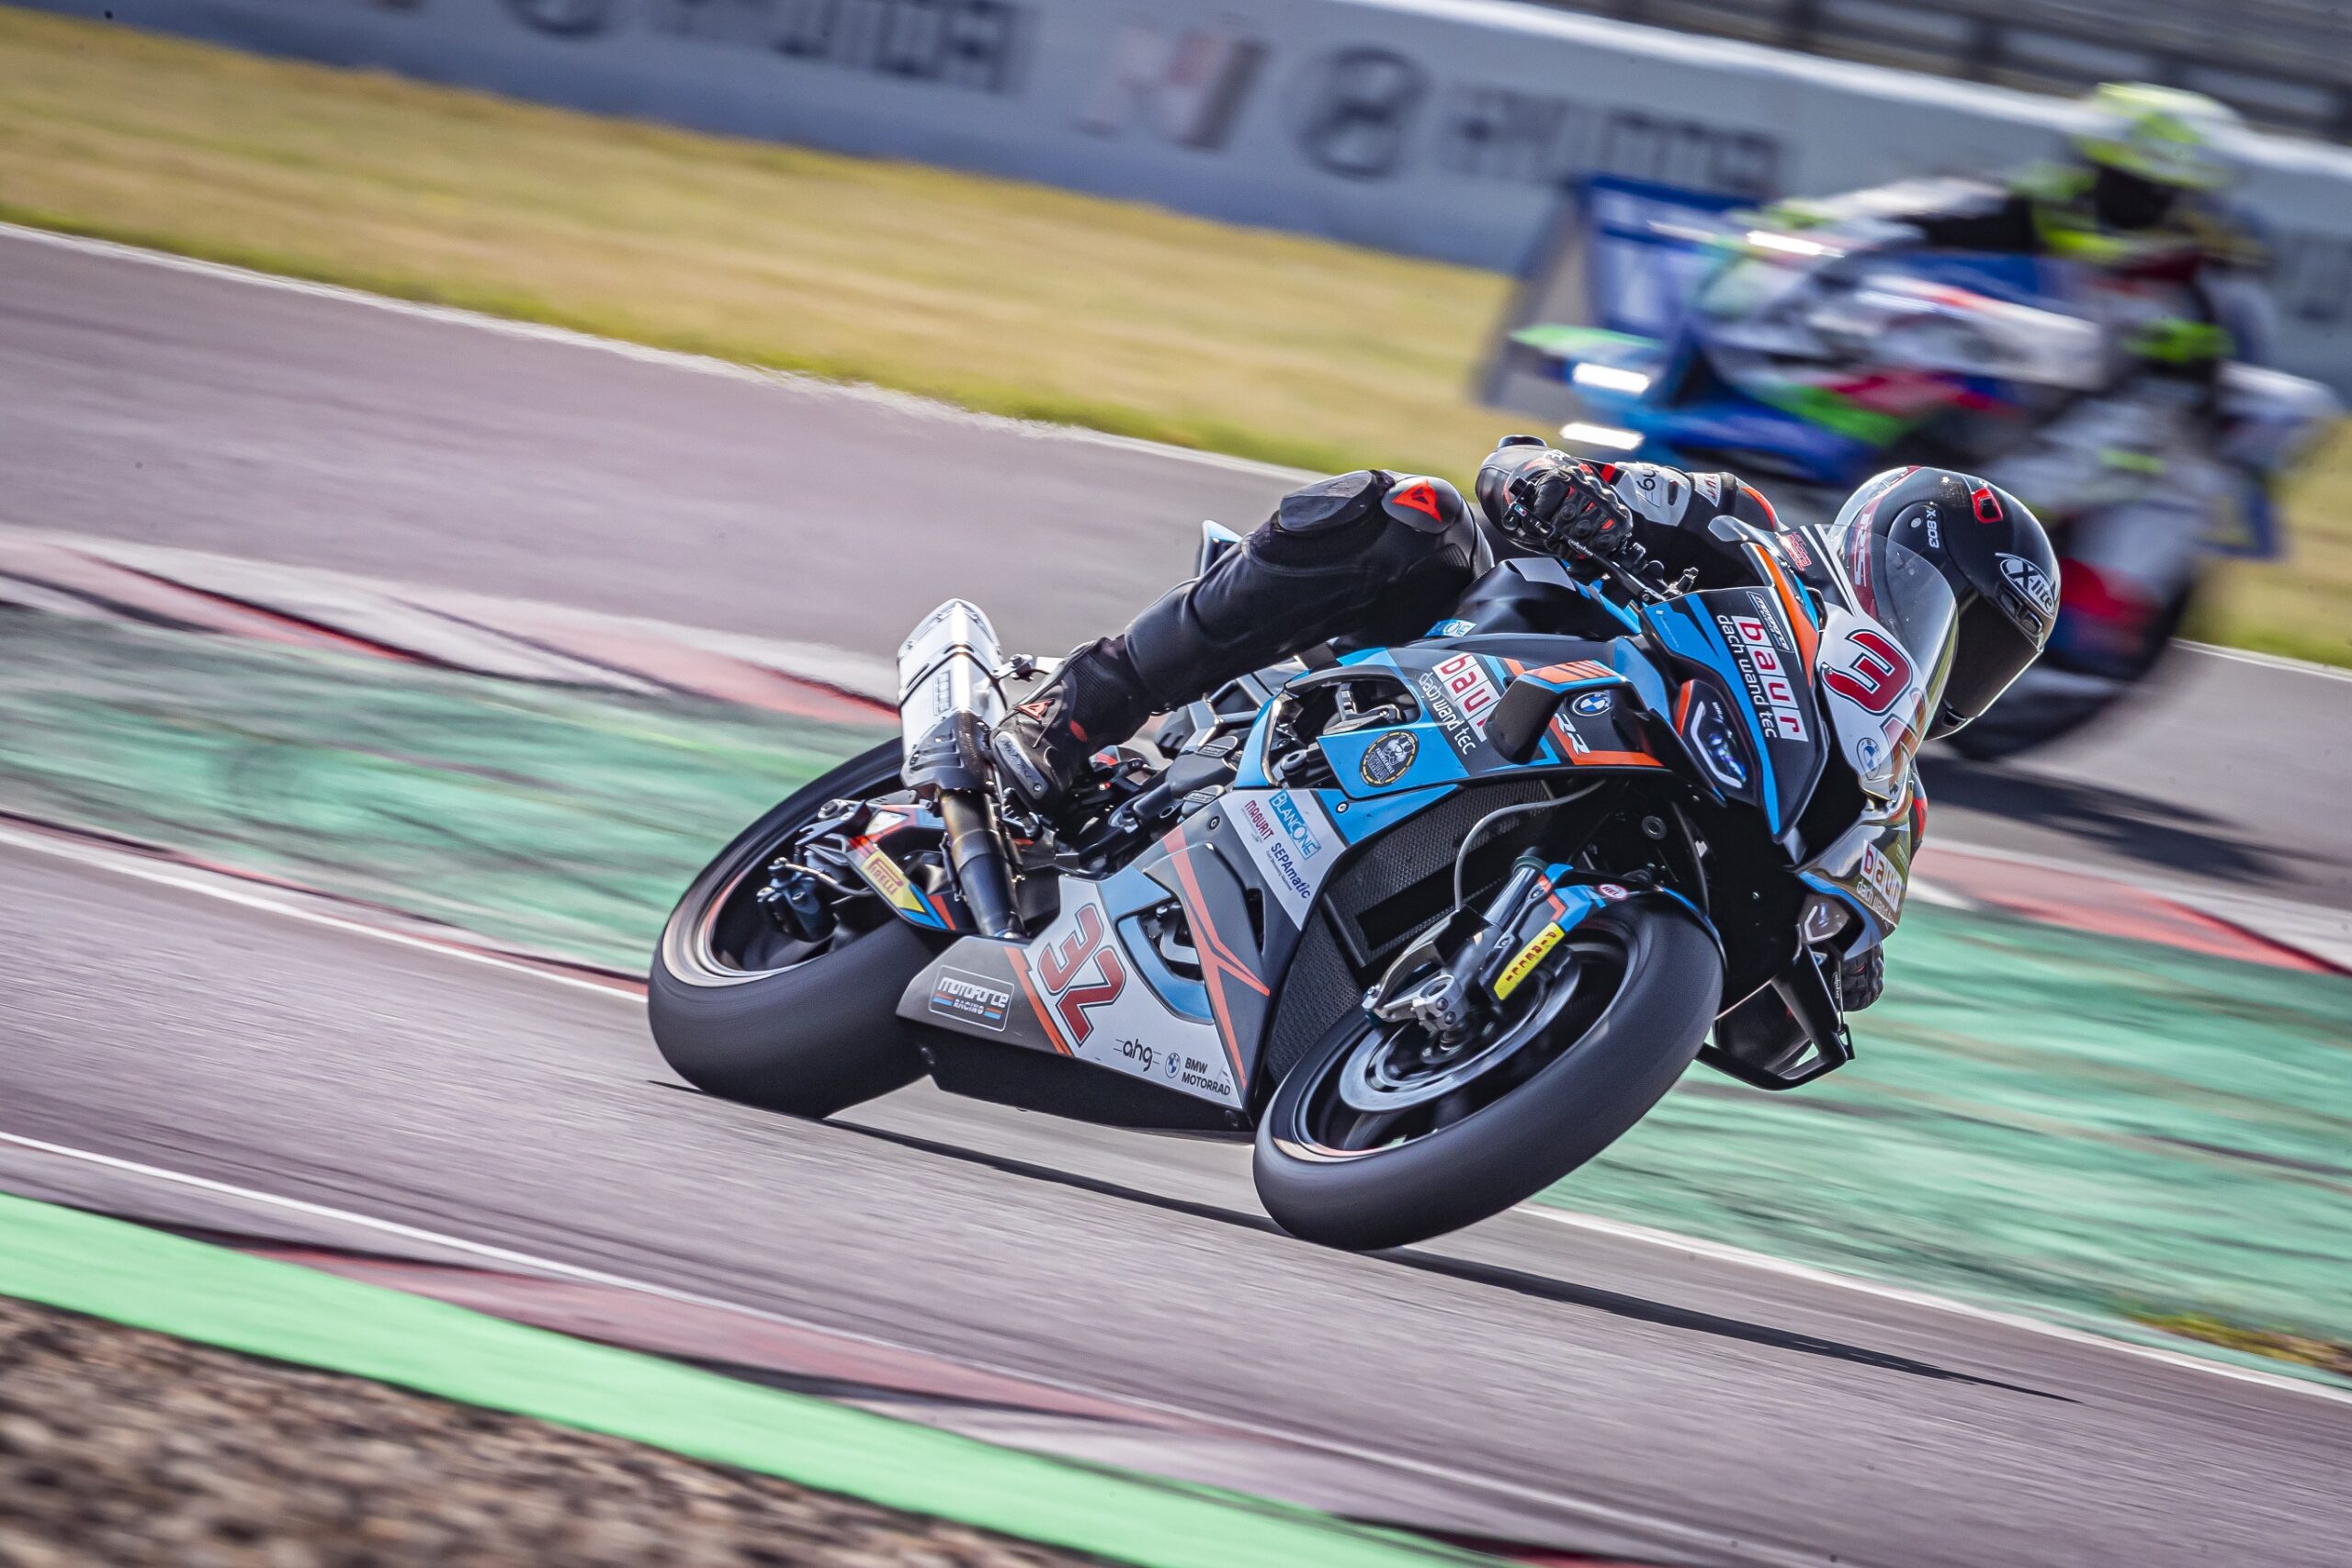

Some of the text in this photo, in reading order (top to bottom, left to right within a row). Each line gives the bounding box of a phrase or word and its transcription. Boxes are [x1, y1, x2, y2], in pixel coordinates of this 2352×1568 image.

[1926, 509, 1939, 548] X-803
[2007, 561, 2052, 611] X-lite
[1419, 671, 1442, 701] dach
[1432, 698, 1465, 731] wand
[1440, 654, 1490, 727] bau
[1716, 615, 1778, 739] dach wand tec
[1739, 622, 1799, 733] baur
[1244, 799, 1274, 840] MAGURIT
[865, 856, 904, 897] PIRELLI
[1271, 841, 1311, 899] SEPAmatic
[1036, 903, 1127, 1047] 32
[1505, 931, 1558, 982] PIRELLI
[1123, 1038, 1154, 1072] ahg
[1184, 1056, 1208, 1074] BMW
[1182, 1071, 1231, 1096] MOTORRAD
